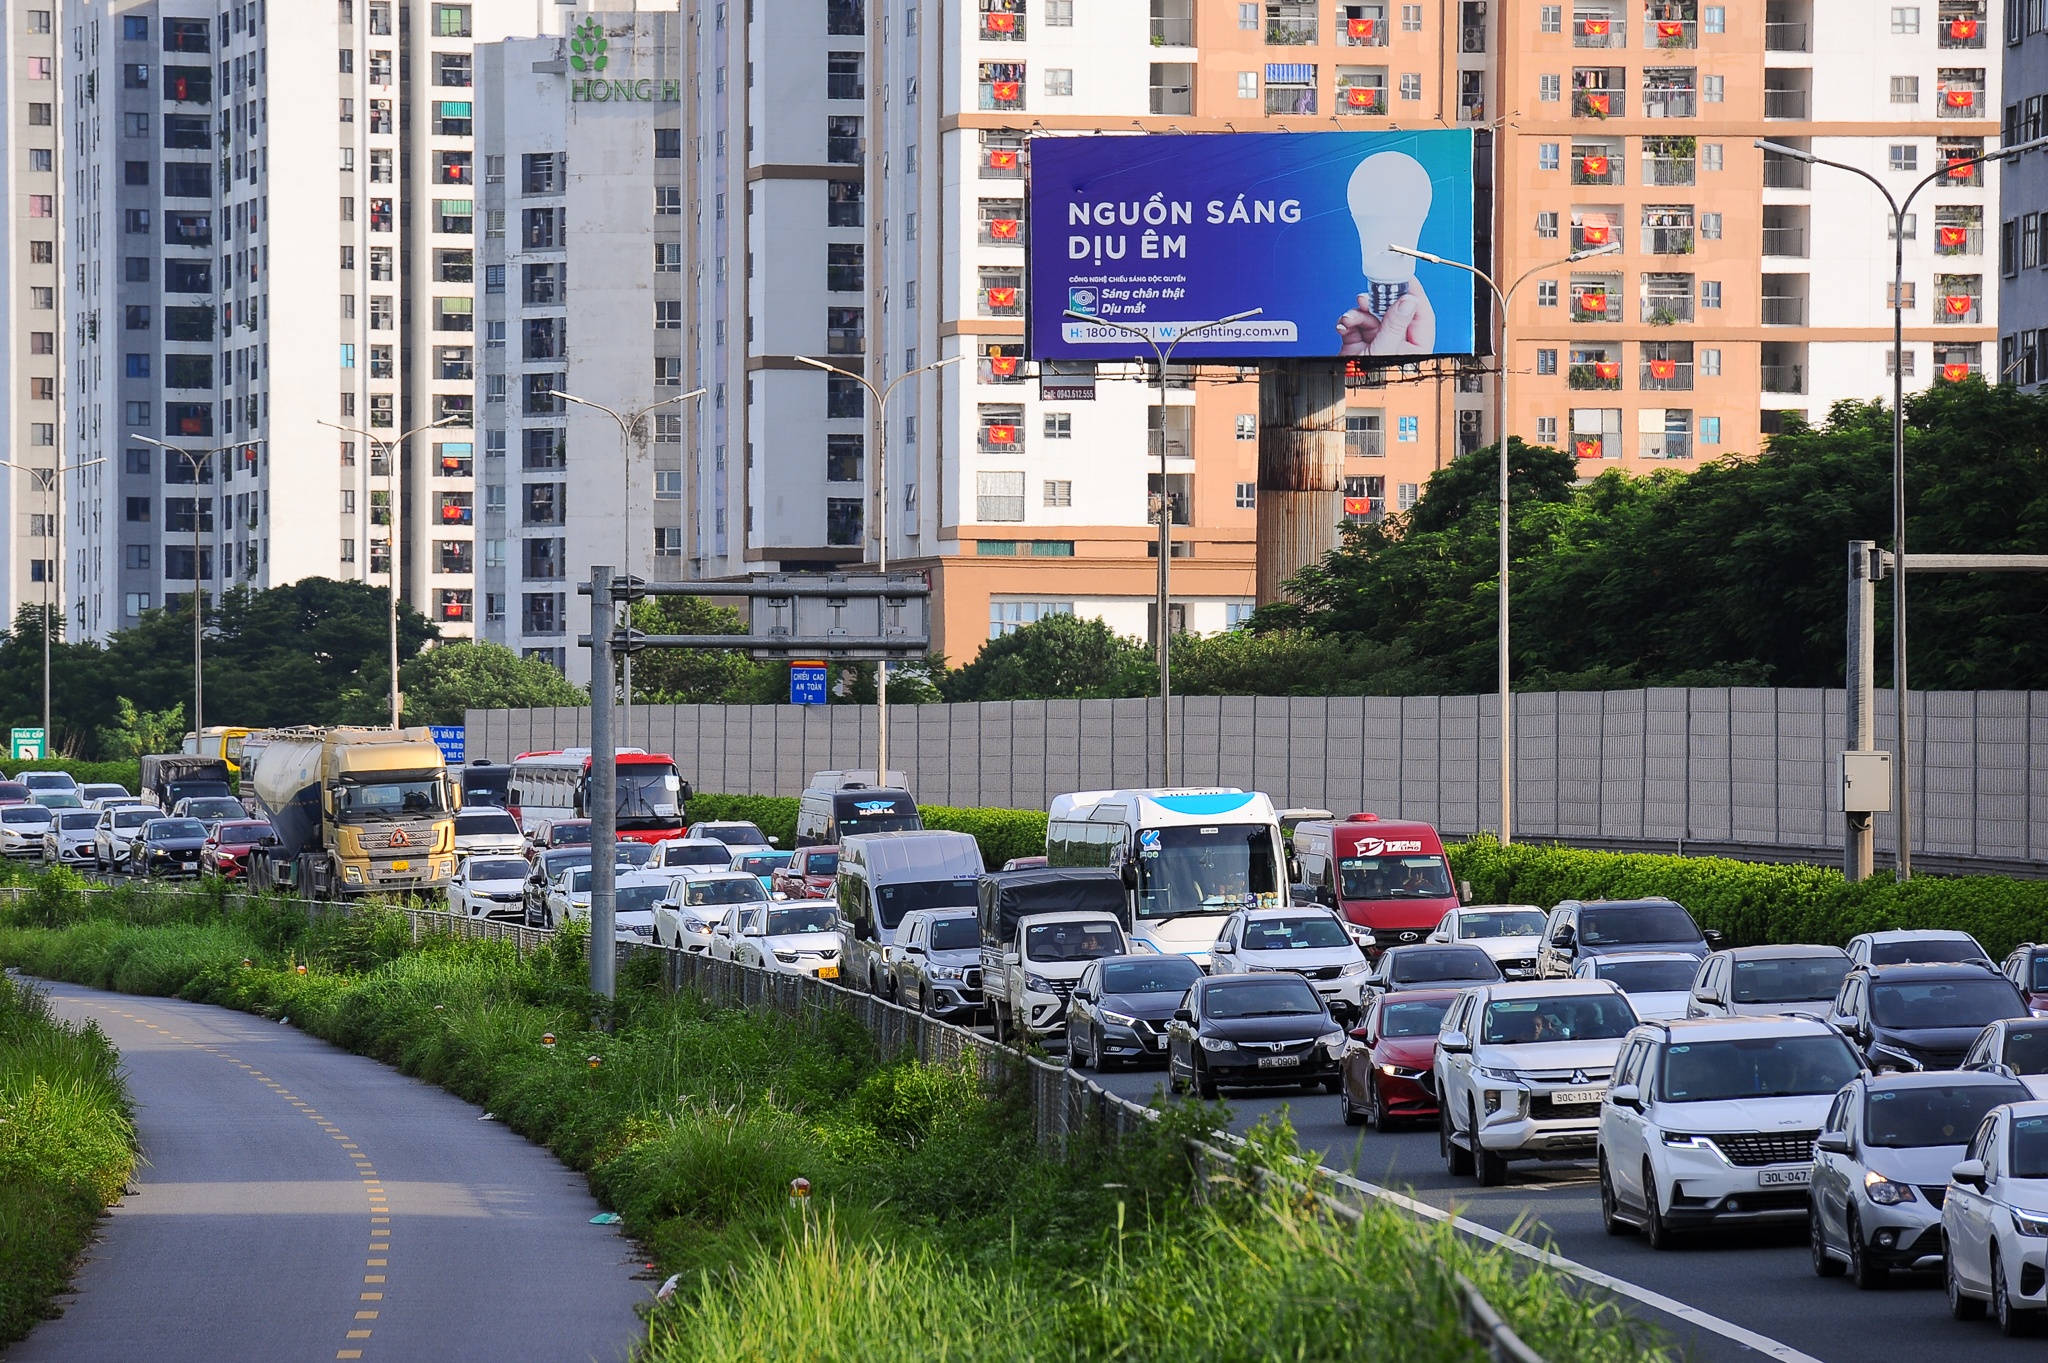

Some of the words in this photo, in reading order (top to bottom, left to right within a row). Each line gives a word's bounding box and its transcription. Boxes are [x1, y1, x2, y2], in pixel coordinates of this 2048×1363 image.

[571, 78, 652, 102] HONG
[660, 78, 680, 101] H
[1068, 191, 1192, 226] NGUỒN
[1206, 193, 1301, 224] SÁNG
[1068, 235, 1126, 266] DỊU
[1141, 228, 1186, 259] ÊM
[1101, 288, 1131, 300] Sáng
[1132, 288, 1160, 299] chân
[1162, 288, 1186, 300] thật
[1101, 303, 1121, 316] Dịu
[1123, 301, 1147, 314] mắt
[1070, 328, 1083, 338] H:
[1086, 327, 1117, 338] 1800
[1159, 327, 1176, 337] W:
[812, 673, 825, 681] CAO
[796, 683, 805, 691] AN
